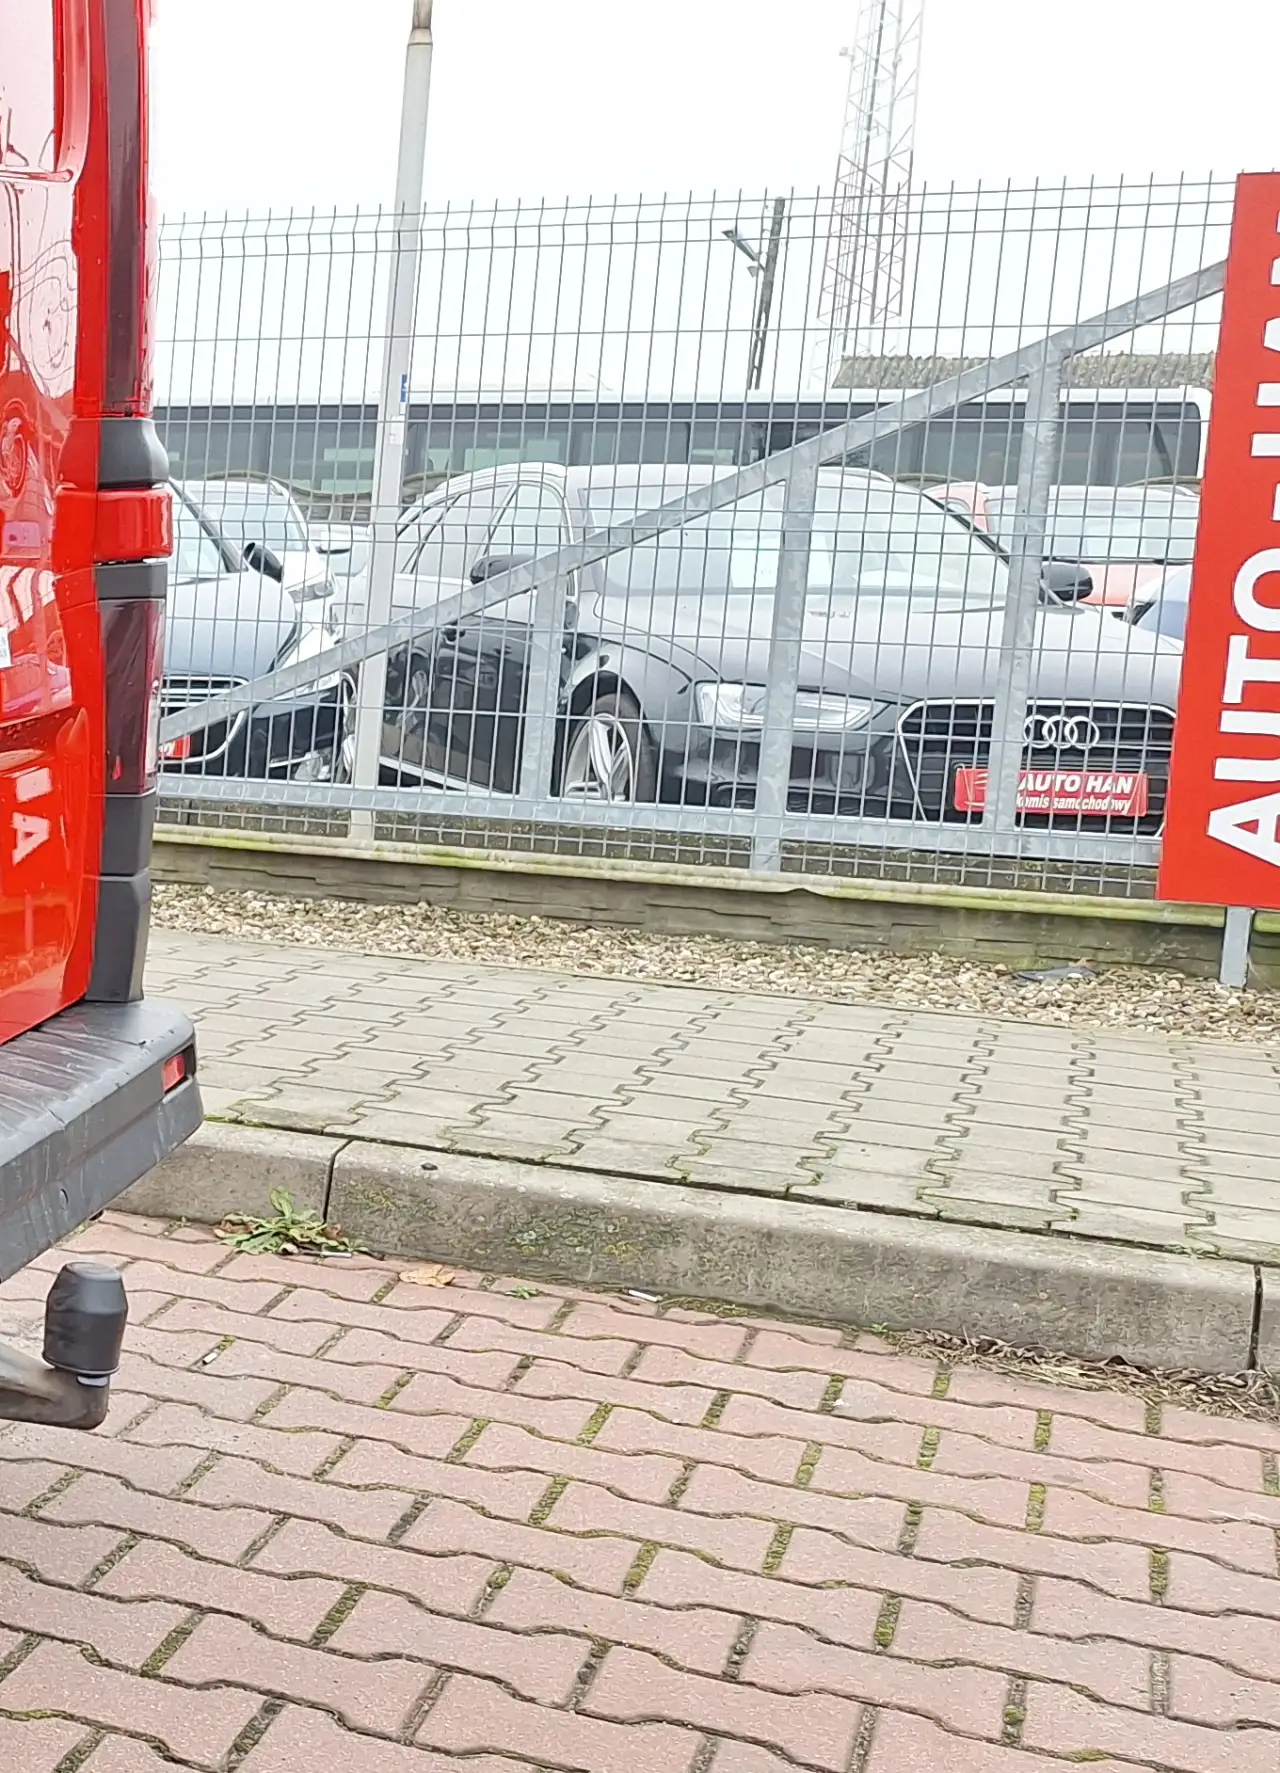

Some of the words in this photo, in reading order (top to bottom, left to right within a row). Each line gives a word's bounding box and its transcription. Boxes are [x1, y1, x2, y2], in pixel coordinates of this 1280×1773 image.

[1017, 773, 1081, 793] AUTO
[1085, 774, 1133, 794] HAN
[1206, 547, 1280, 868] AUTO
